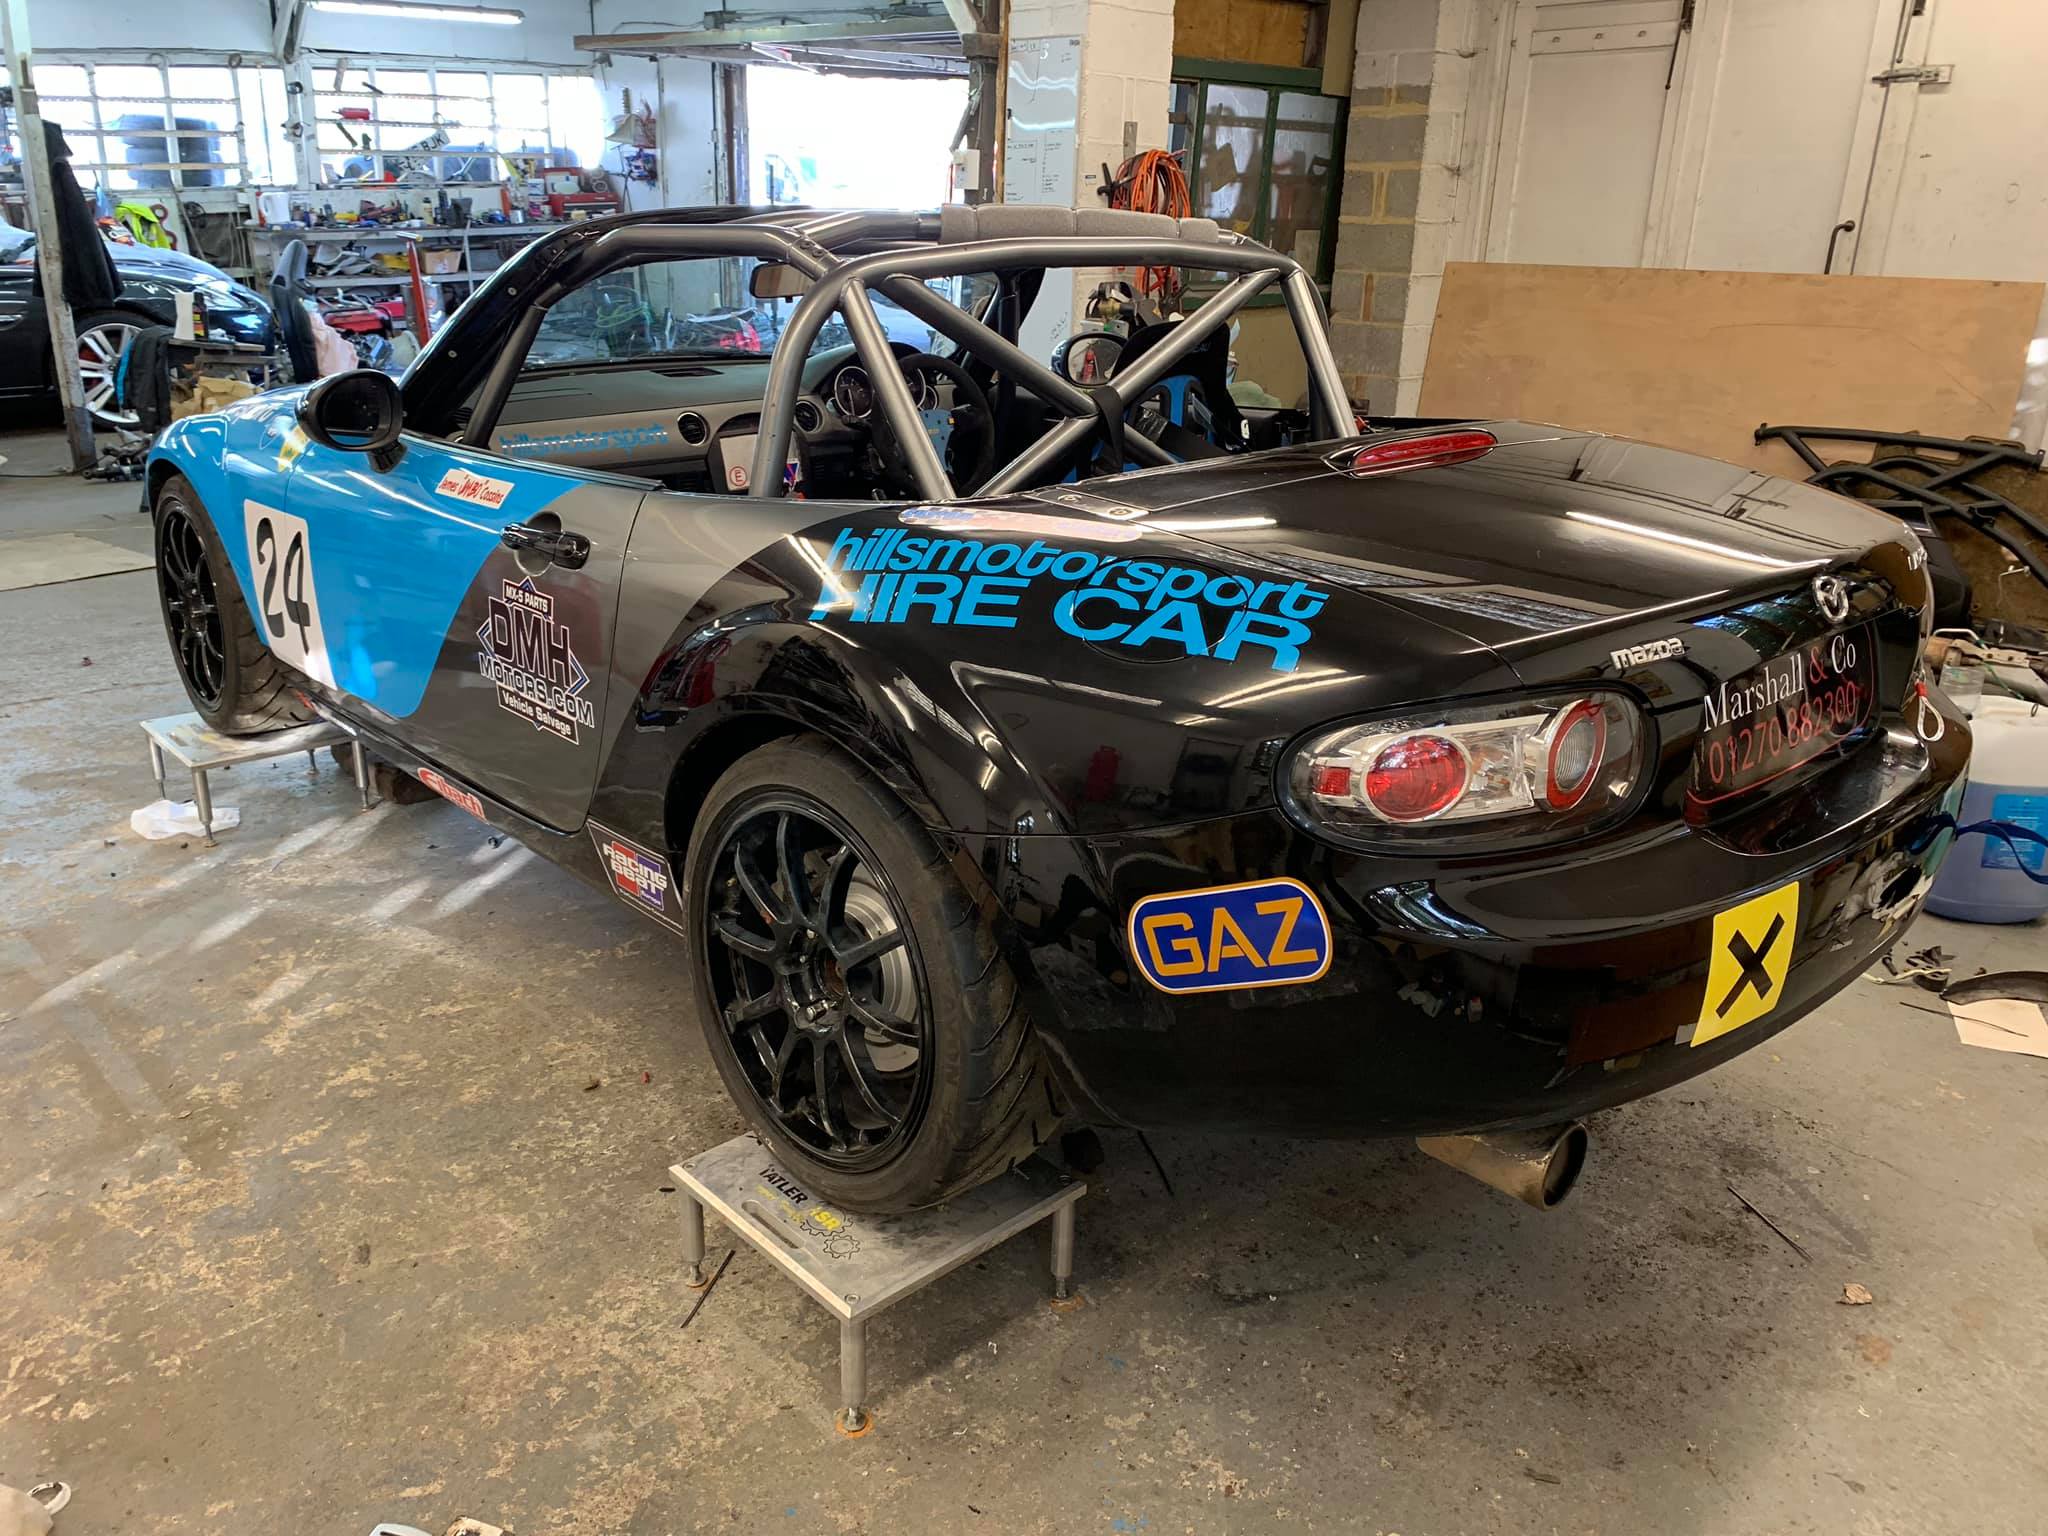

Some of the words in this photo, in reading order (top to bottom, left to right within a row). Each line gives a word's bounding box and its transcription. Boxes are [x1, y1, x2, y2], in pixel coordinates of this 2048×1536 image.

[256, 517, 311, 657] 24
[505, 584, 524, 604] MX-5
[525, 592, 549, 613] PARTS
[824, 527, 1330, 620] hillsmotorsport
[488, 596, 572, 689] DMH
[807, 572, 1032, 629] HIRE
[1053, 588, 1312, 673] CAR
[478, 651, 595, 729] MOTORS.COM
[502, 690, 535, 717] Vehicle
[536, 706, 572, 736] Salvage
[1703, 653, 1805, 733] Marshall
[1809, 646, 1829, 684] &
[1831, 635, 1856, 674] Co
[1709, 716, 1783, 785] 01270
[1786, 680, 1857, 750] 882300
[1142, 896, 1319, 977] GAZ
